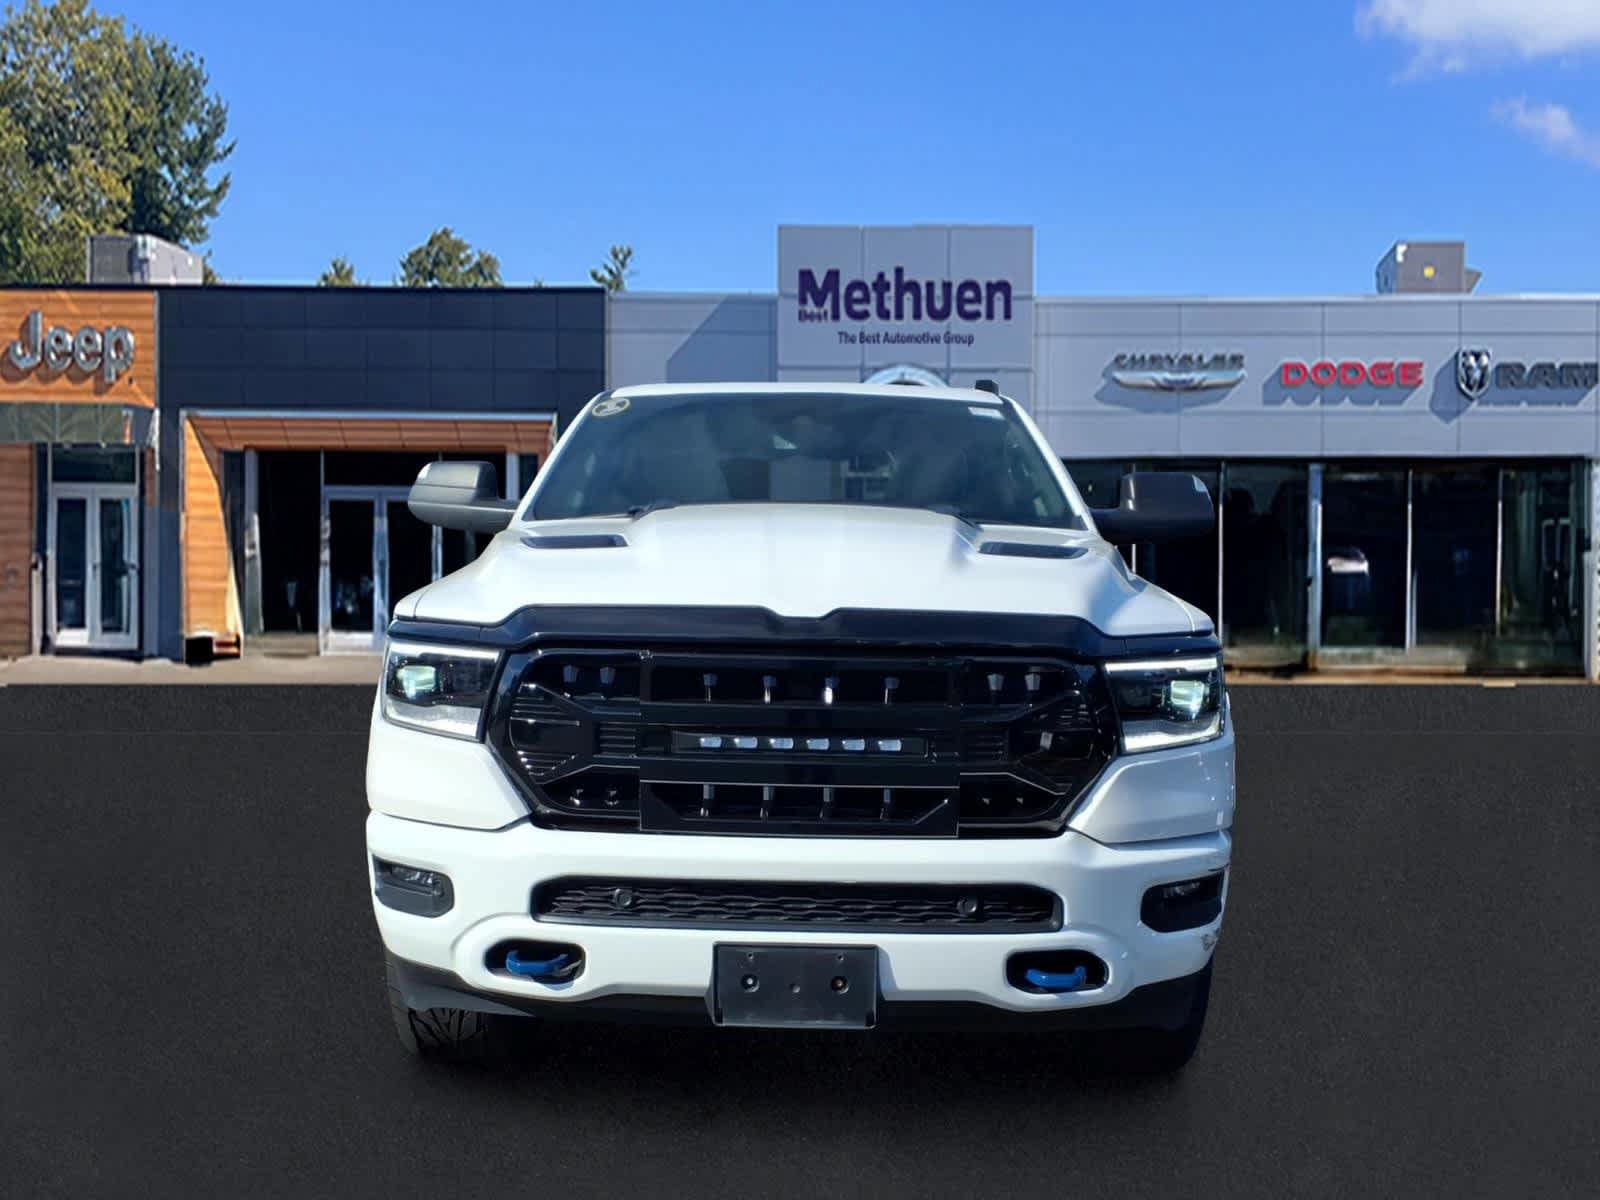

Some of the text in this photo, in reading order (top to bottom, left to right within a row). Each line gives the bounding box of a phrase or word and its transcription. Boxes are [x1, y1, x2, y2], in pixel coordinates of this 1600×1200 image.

[798, 266, 1012, 321] Methuen
[9, 310, 135, 384] Jeep
[838, 331, 975, 347] The Best Automotive Group
[1114, 353, 1245, 370] CHRYSLER
[1281, 361, 1424, 386] DODGE
[1494, 362, 1599, 389] RAM
